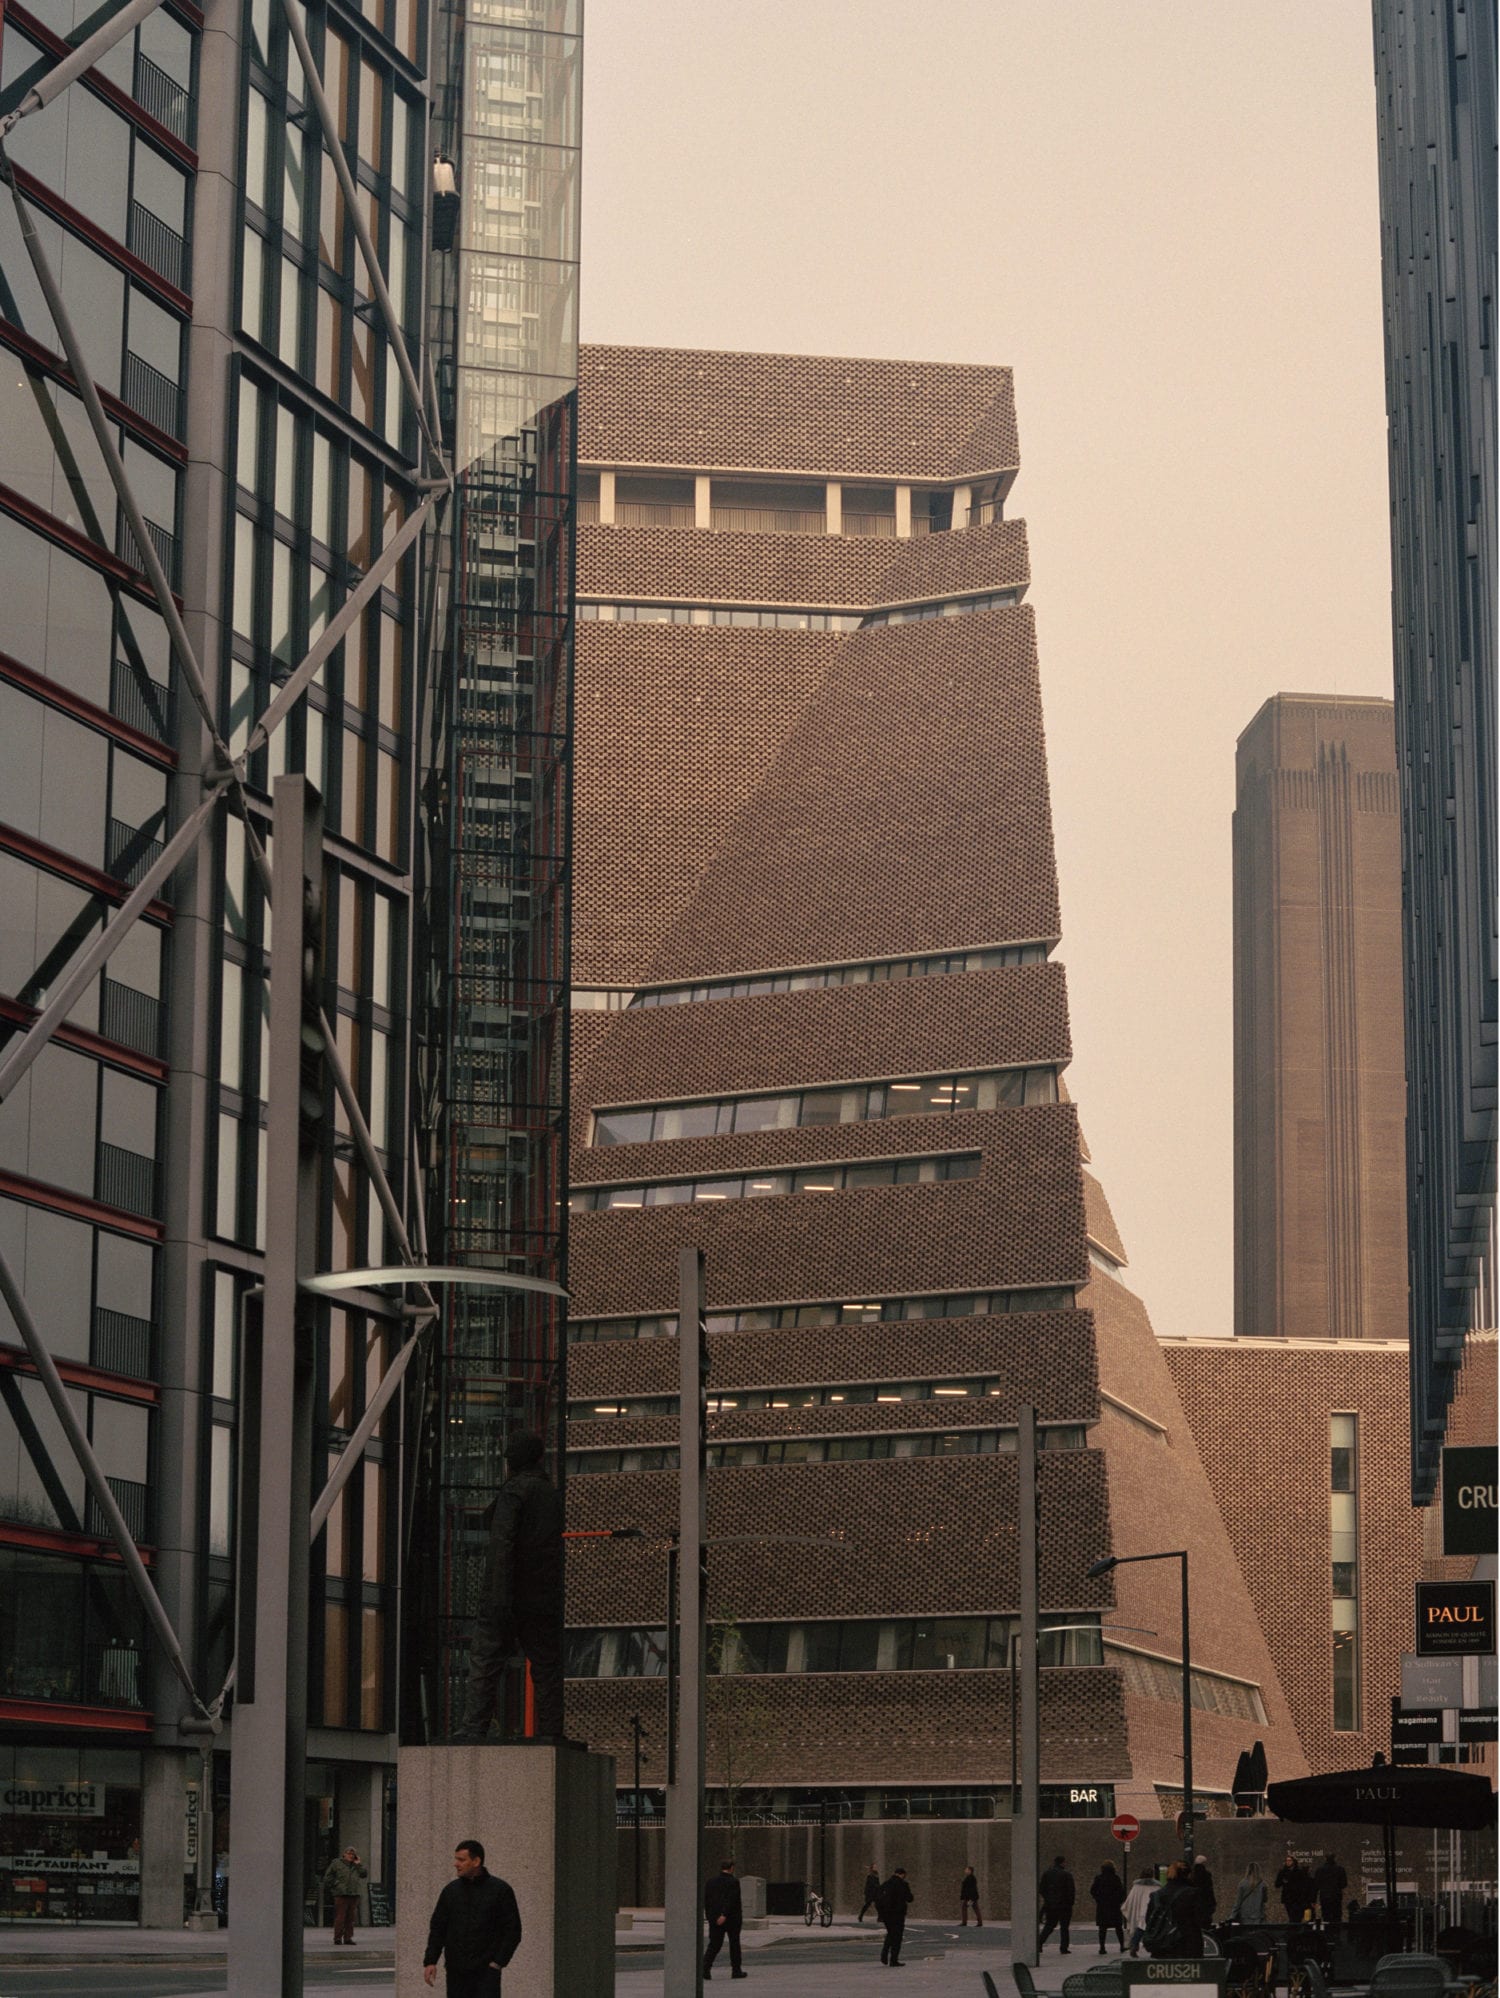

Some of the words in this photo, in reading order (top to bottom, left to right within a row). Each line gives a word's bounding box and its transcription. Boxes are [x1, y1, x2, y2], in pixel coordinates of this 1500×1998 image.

[1458, 1485, 1497, 1509] CRU
[1427, 1606, 1484, 1623] PAUL
[1397, 1717, 1438, 1726] wagamama
[4, 1785, 95, 1812] capricci
[1070, 1789, 1098, 1803] BAR
[1356, 1787, 1401, 1800] PAUL
[185, 1790, 198, 1857] capricci
[15, 1859, 110, 1870] RESTAURANT
[1146, 1963, 1201, 1979] CRUSSH
